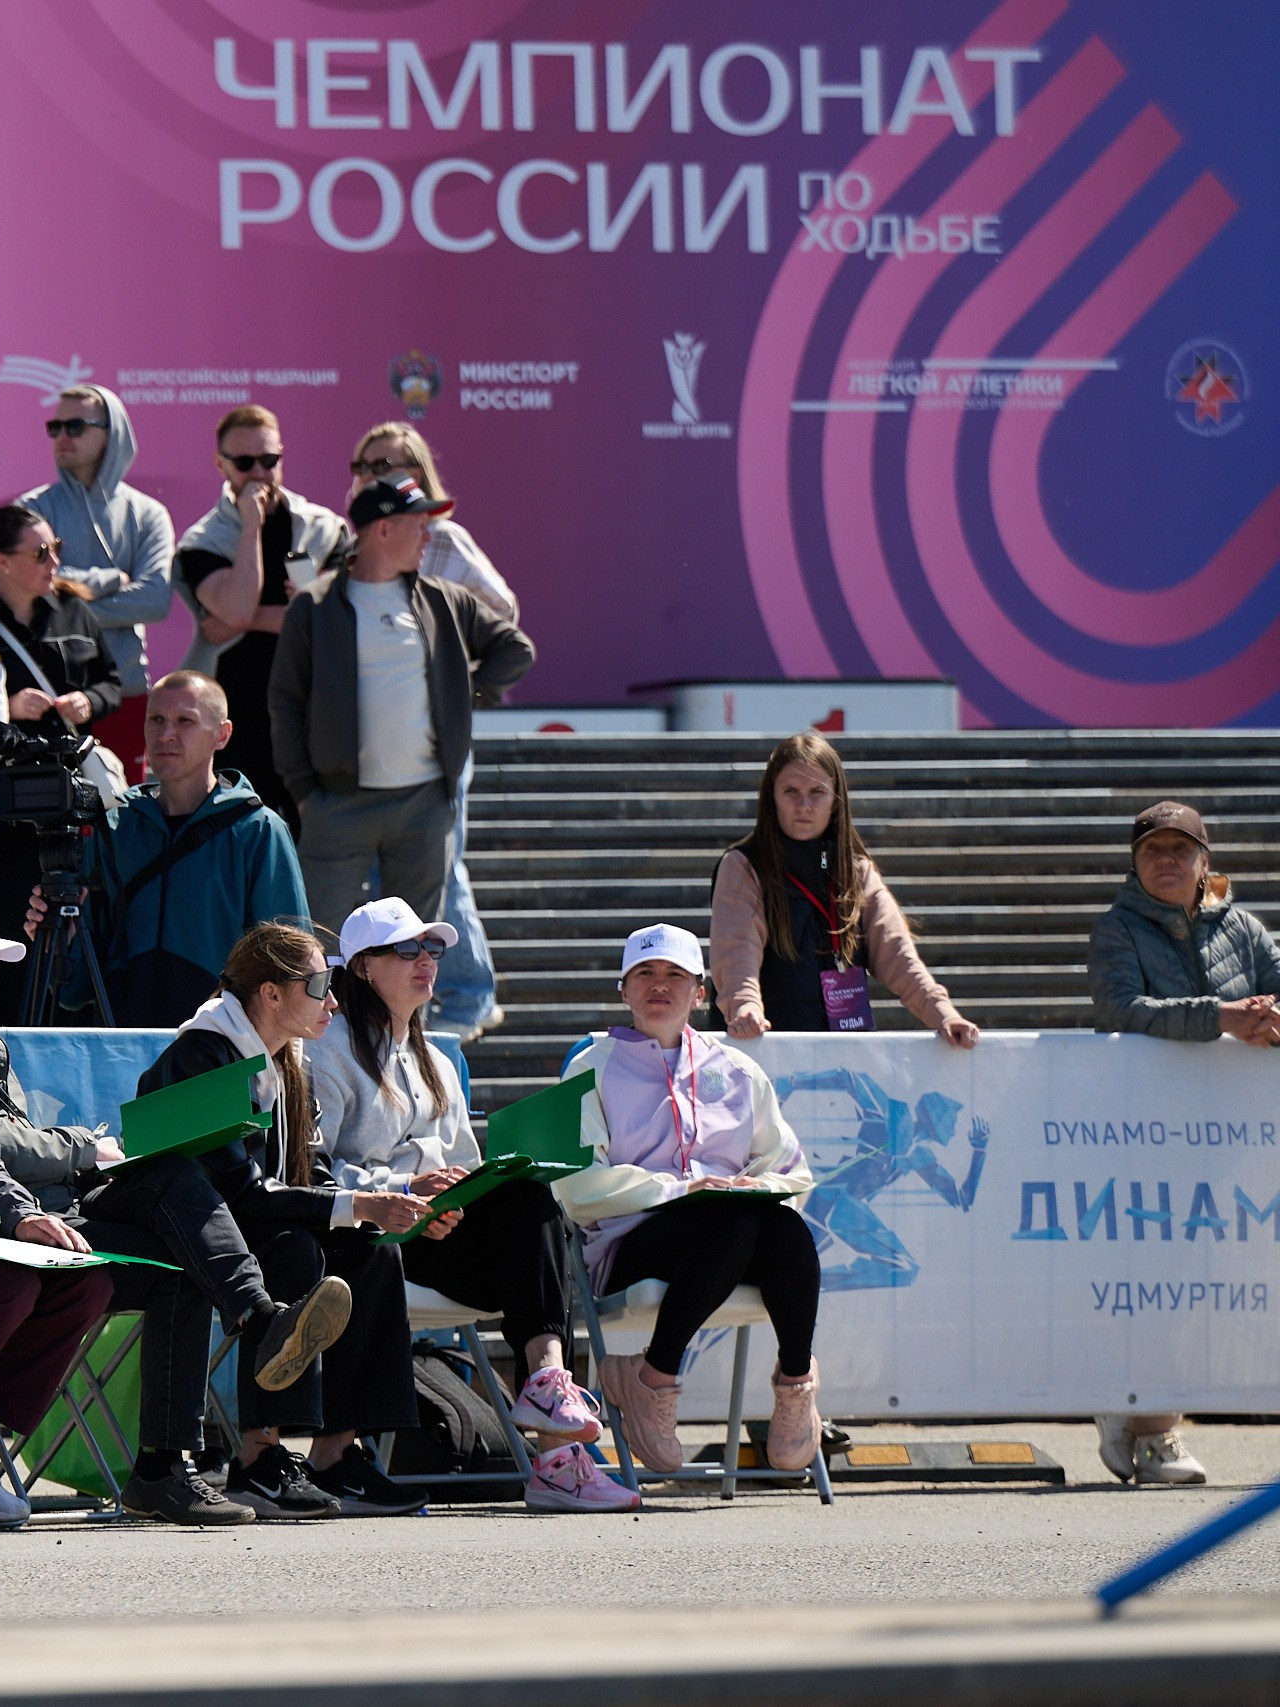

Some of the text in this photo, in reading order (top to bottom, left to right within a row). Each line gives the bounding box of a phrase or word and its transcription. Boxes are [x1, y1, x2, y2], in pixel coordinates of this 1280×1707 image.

[213, 38, 1042, 137] ЧЕМПИОНАТ
[218, 158, 769, 254] РОССИИ
[798, 172, 873, 212] ПО
[798, 215, 1004, 260] ХОДЬБЕ
[459, 361, 580, 384] МИНСПОРТ
[848, 372, 1063, 396] ЛЕГКОЙ АТЛЕТИКИ
[460, 388, 553, 411] РОССИИ
[839, 1016, 864, 1030] СУДЬЯ
[1043, 1120, 1276, 1146] DYNAMO-UDM.R
[1011, 1177, 1280, 1242] ДИНАМ
[1090, 1281, 1269, 1317] УДМУРТИЯ
